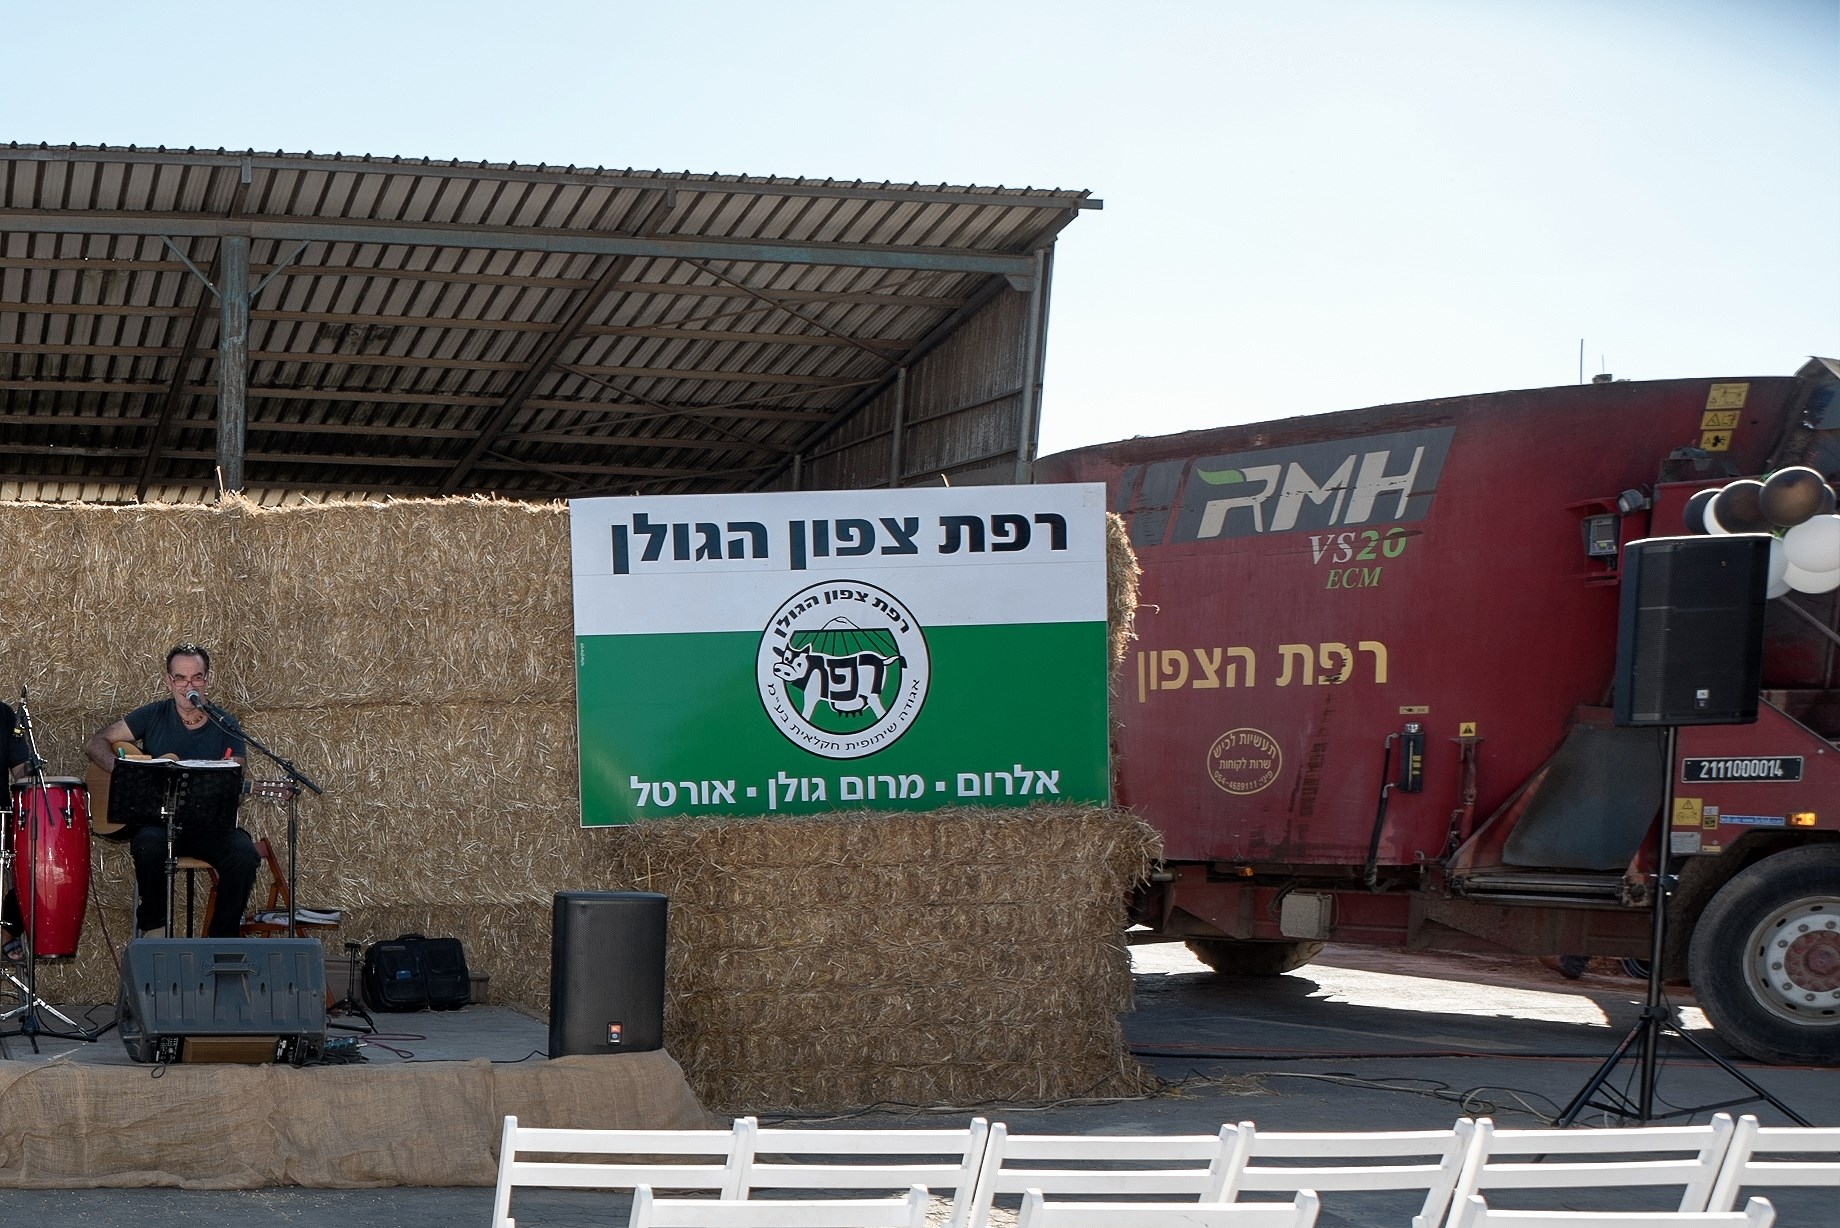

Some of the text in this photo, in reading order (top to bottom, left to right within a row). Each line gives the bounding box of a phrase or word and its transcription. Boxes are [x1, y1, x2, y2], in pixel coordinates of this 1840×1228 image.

[1197, 446, 1424, 539] RMH
[611, 512, 1068, 575] רפת צפון הגולן
[1309, 527, 1408, 565] VS20
[1325, 566, 1383, 590] ECM
[774, 589, 910, 639] רפת צפון הגולן
[1138, 640, 1388, 703] רפת הצפון
[898, 679, 920, 721] אגודה
[789, 723, 840, 750] חקלאית
[845, 722, 898, 751] שיתופית
[1213, 733, 1277, 759] תעשיות לכיש
[1219, 757, 1272, 771] שרות לקוחות
[1699, 759, 1784, 778] 2111000014
[629, 764, 1060, 810] אלרום מרום גולן אורטל
